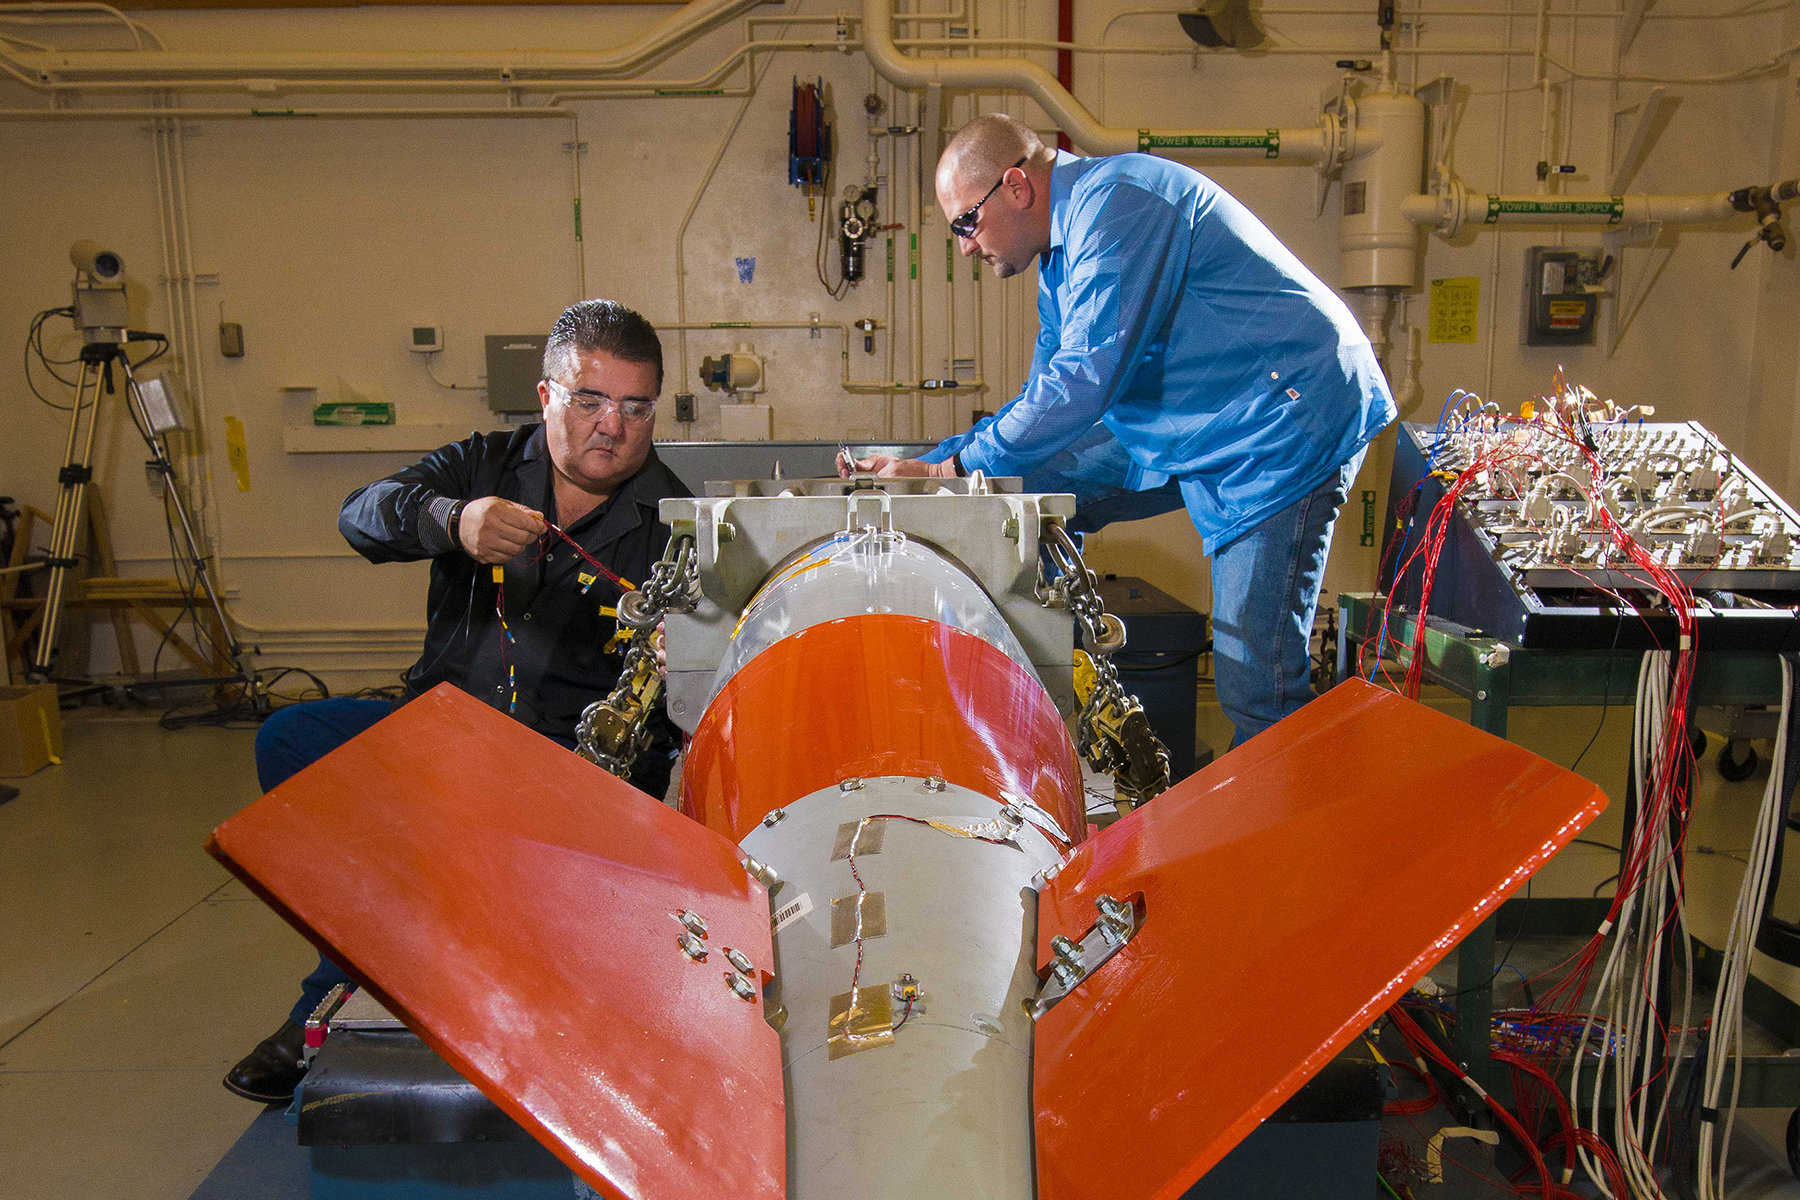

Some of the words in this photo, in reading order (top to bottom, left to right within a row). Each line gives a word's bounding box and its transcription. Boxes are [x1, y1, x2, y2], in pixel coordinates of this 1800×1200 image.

[1153, 137, 1188, 146] TOWER
[1192, 137, 1226, 146] WATER
[1229, 137, 1265, 146] SUPPLY
[1501, 203, 1536, 212] TOWER
[1540, 203, 1572, 212] WATER
[1576, 203, 1610, 212] SUPPLY
[1366, 504, 1374, 534] DRAIN
